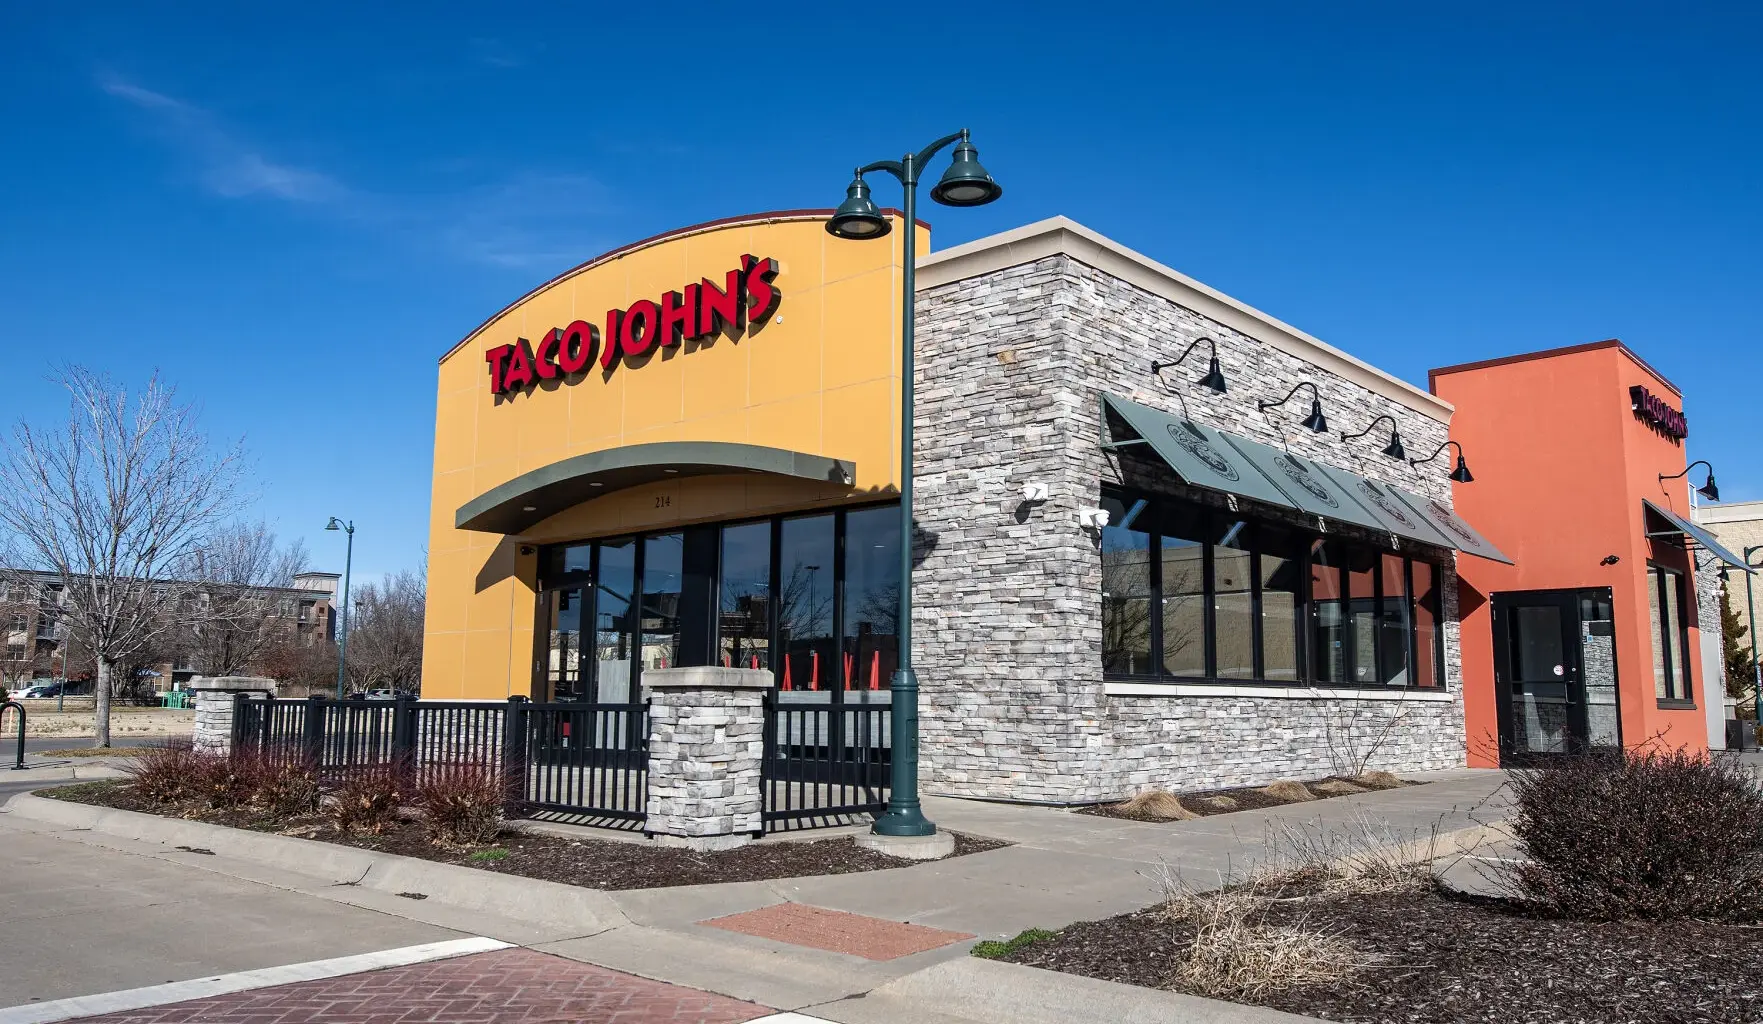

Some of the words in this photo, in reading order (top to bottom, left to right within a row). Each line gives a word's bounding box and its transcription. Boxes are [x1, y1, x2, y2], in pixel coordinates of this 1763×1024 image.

[486, 320, 596, 394] TACO
[600, 254, 778, 370] JOHN'S
[655, 495, 671, 508] 214
